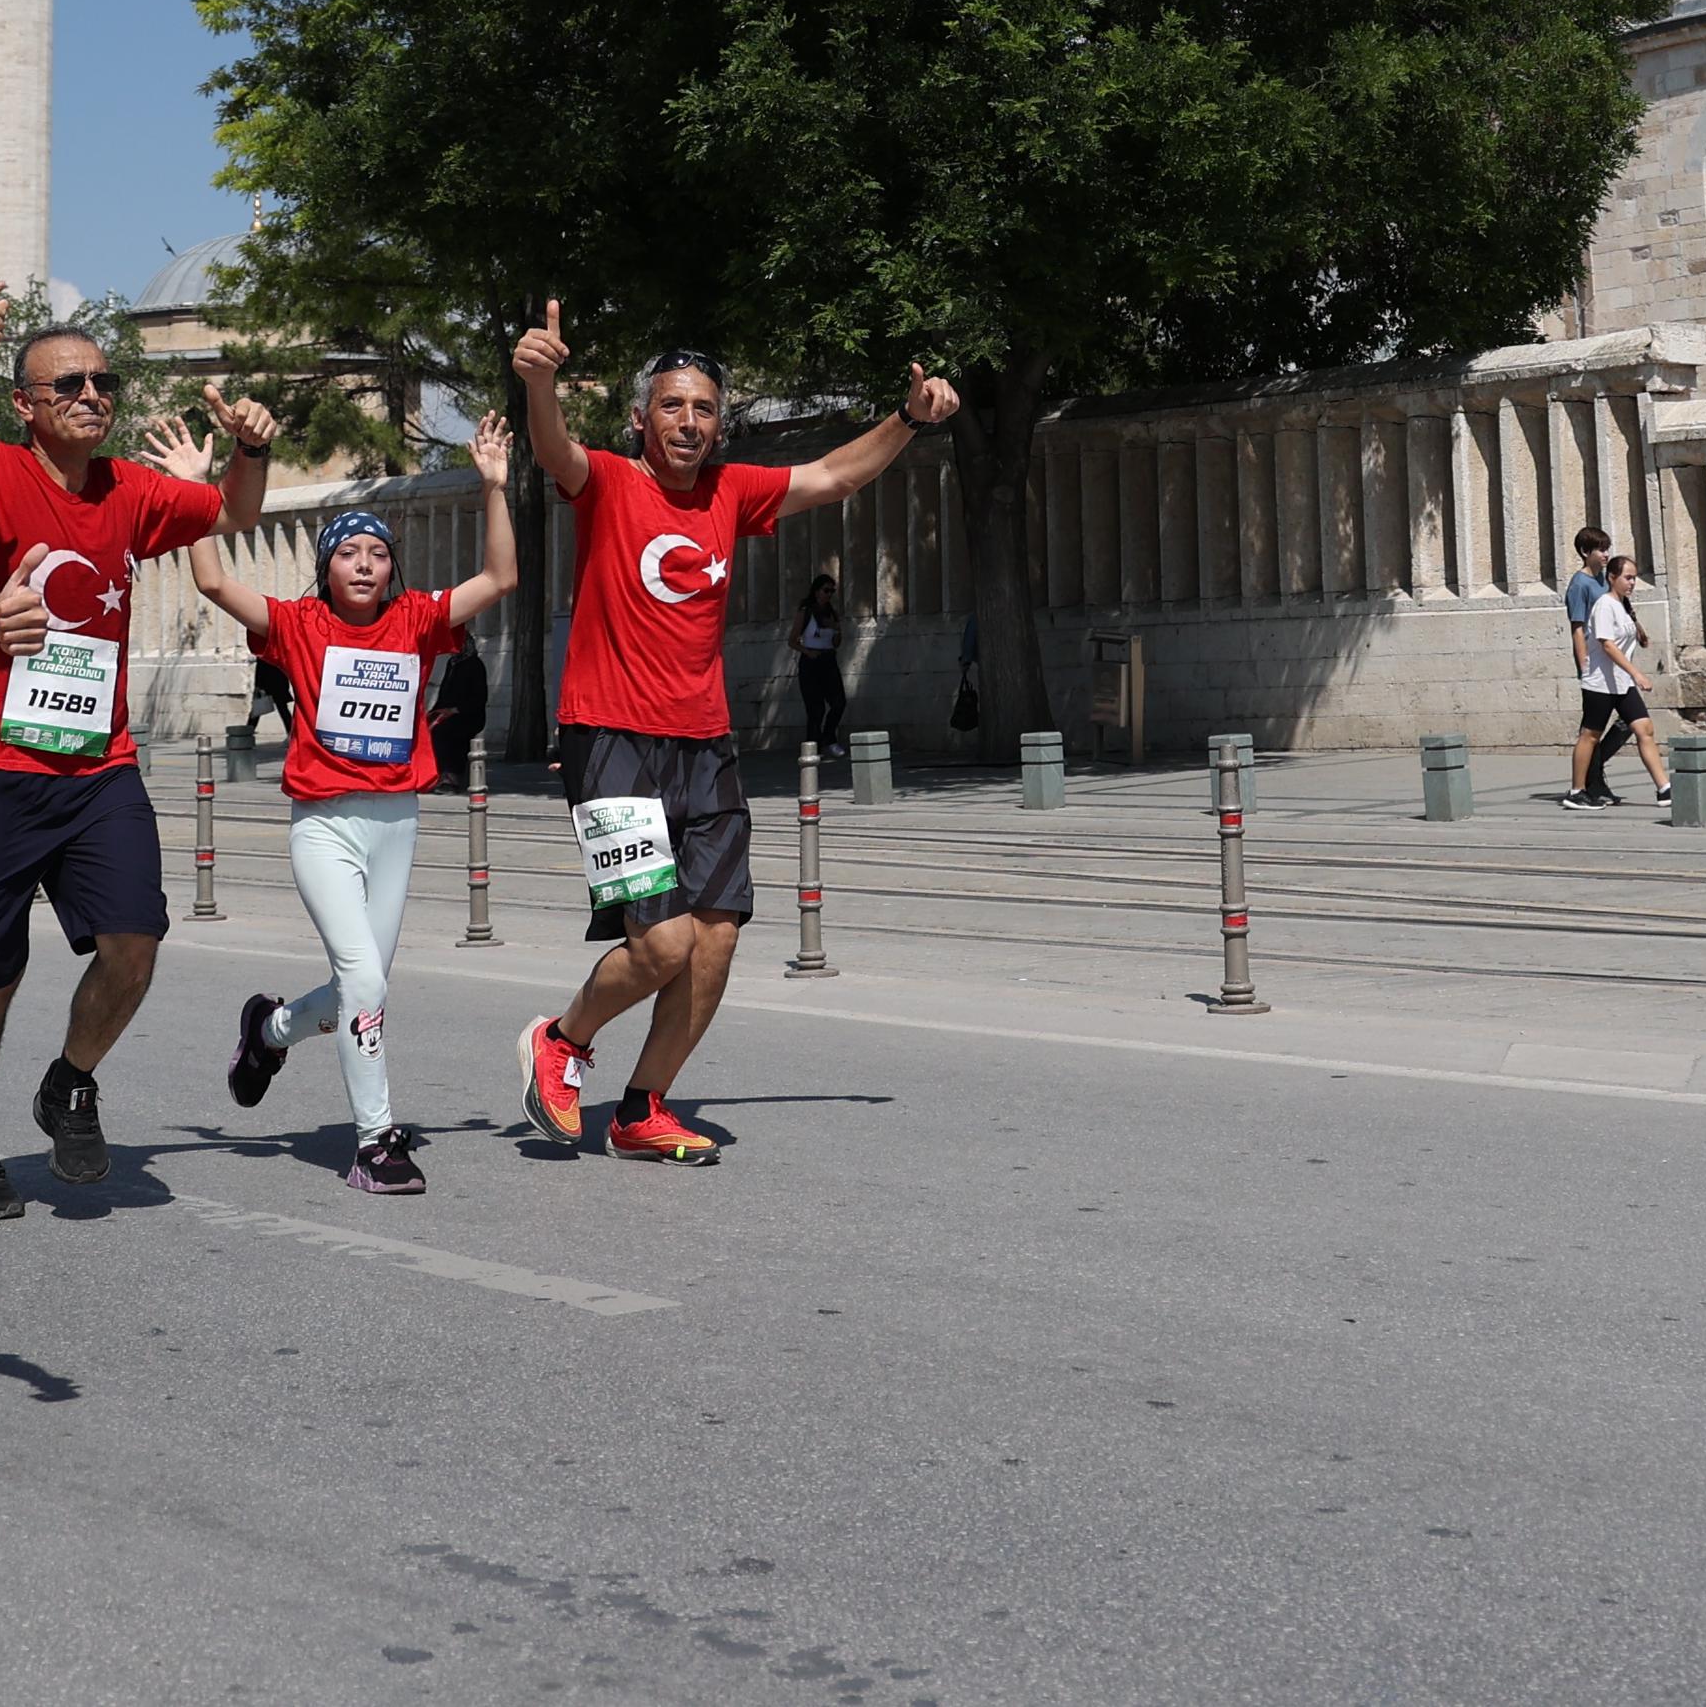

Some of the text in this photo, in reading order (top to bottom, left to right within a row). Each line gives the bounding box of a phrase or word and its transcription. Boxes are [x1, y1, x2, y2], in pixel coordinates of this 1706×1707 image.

[52, 646, 91, 660] KONYA
[58, 655, 84, 667] YARI
[357, 661, 397, 673] KONYA
[32, 661, 102, 679] MARATONU
[363, 671, 391, 681] YARI
[340, 676, 406, 690] MARATONU
[28, 688, 97, 715] 11589
[339, 701, 401, 722] 0702
[592, 807, 632, 818] KONYA
[599, 816, 628, 825] YARI
[588, 819, 647, 838] MARATONU
[592, 840, 654, 871] 10992
